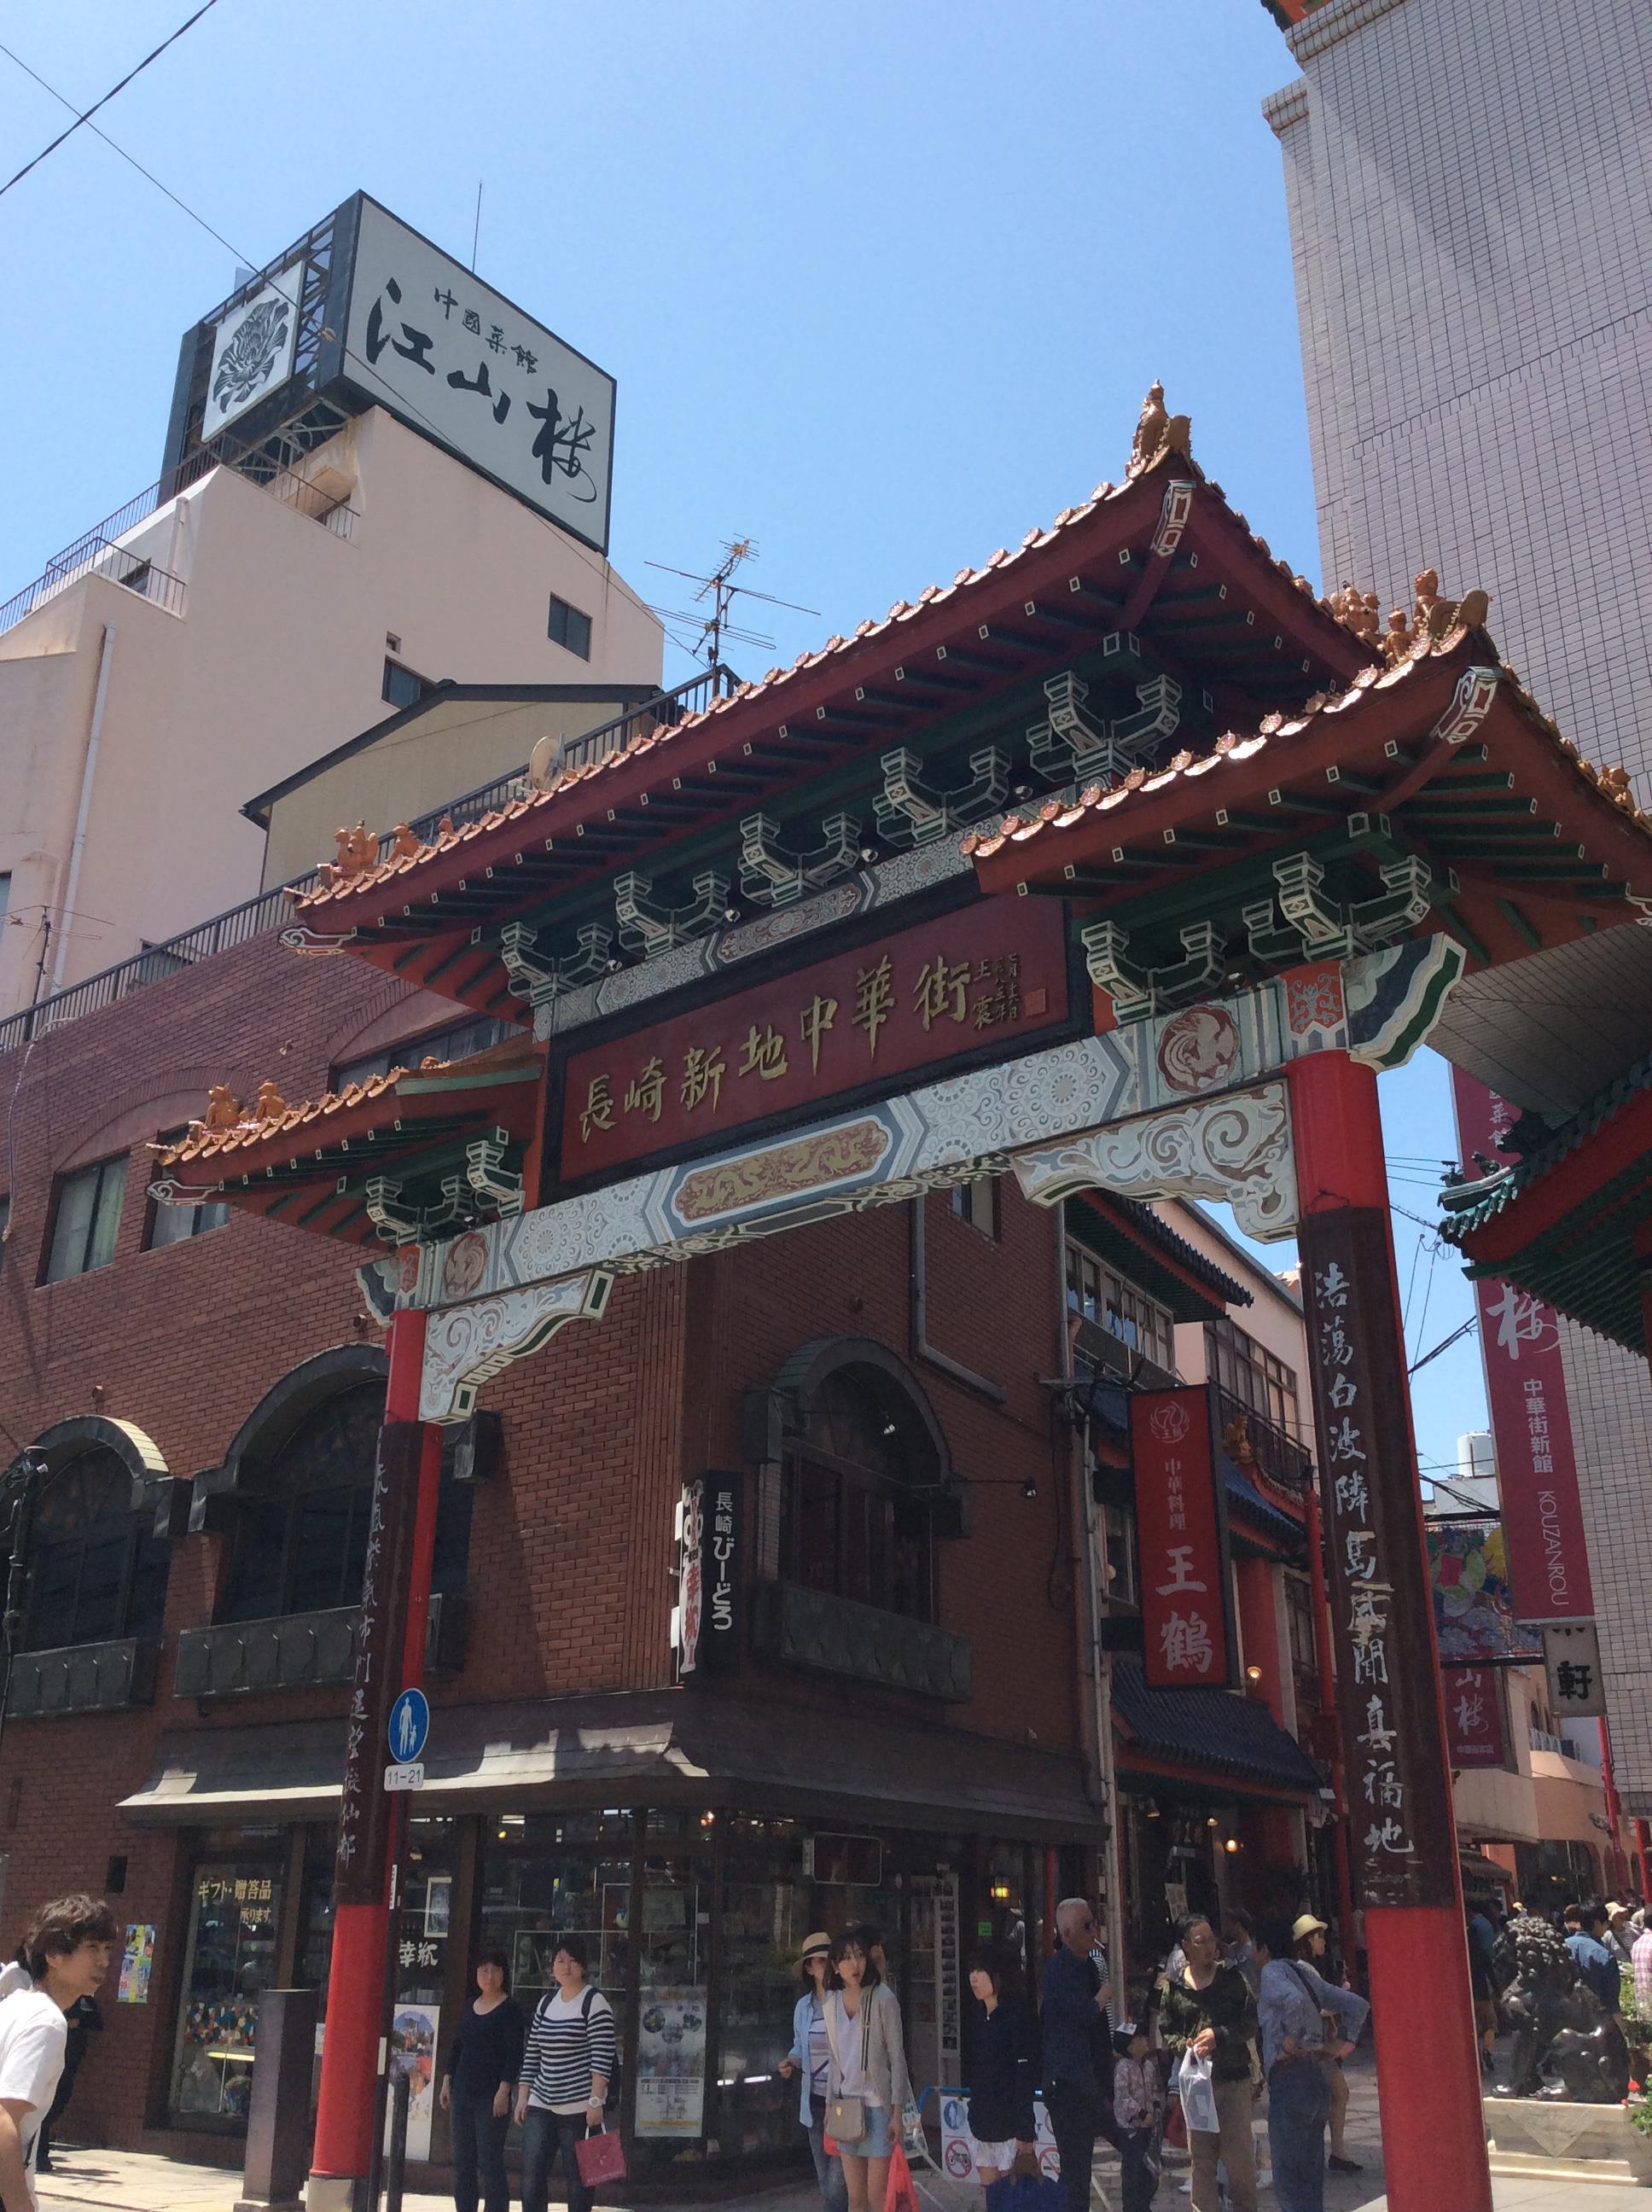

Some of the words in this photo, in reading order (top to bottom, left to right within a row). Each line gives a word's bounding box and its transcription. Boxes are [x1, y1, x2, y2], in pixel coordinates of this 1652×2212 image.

[433, 287, 539, 375] 中國菜館
[579, 954, 971, 1144] 長崎新地中華街
[1523, 1378, 1553, 1474] 中華街新館
[1164, 1457, 1188, 1530] 中華料理
[712, 1492, 735, 1631] 長崎びーどろ
[1537, 1489, 1569, 1606] KOUZANROU
[1155, 1545, 1213, 1674] 王鶴
[387, 1769, 422, 1784] 11-21
